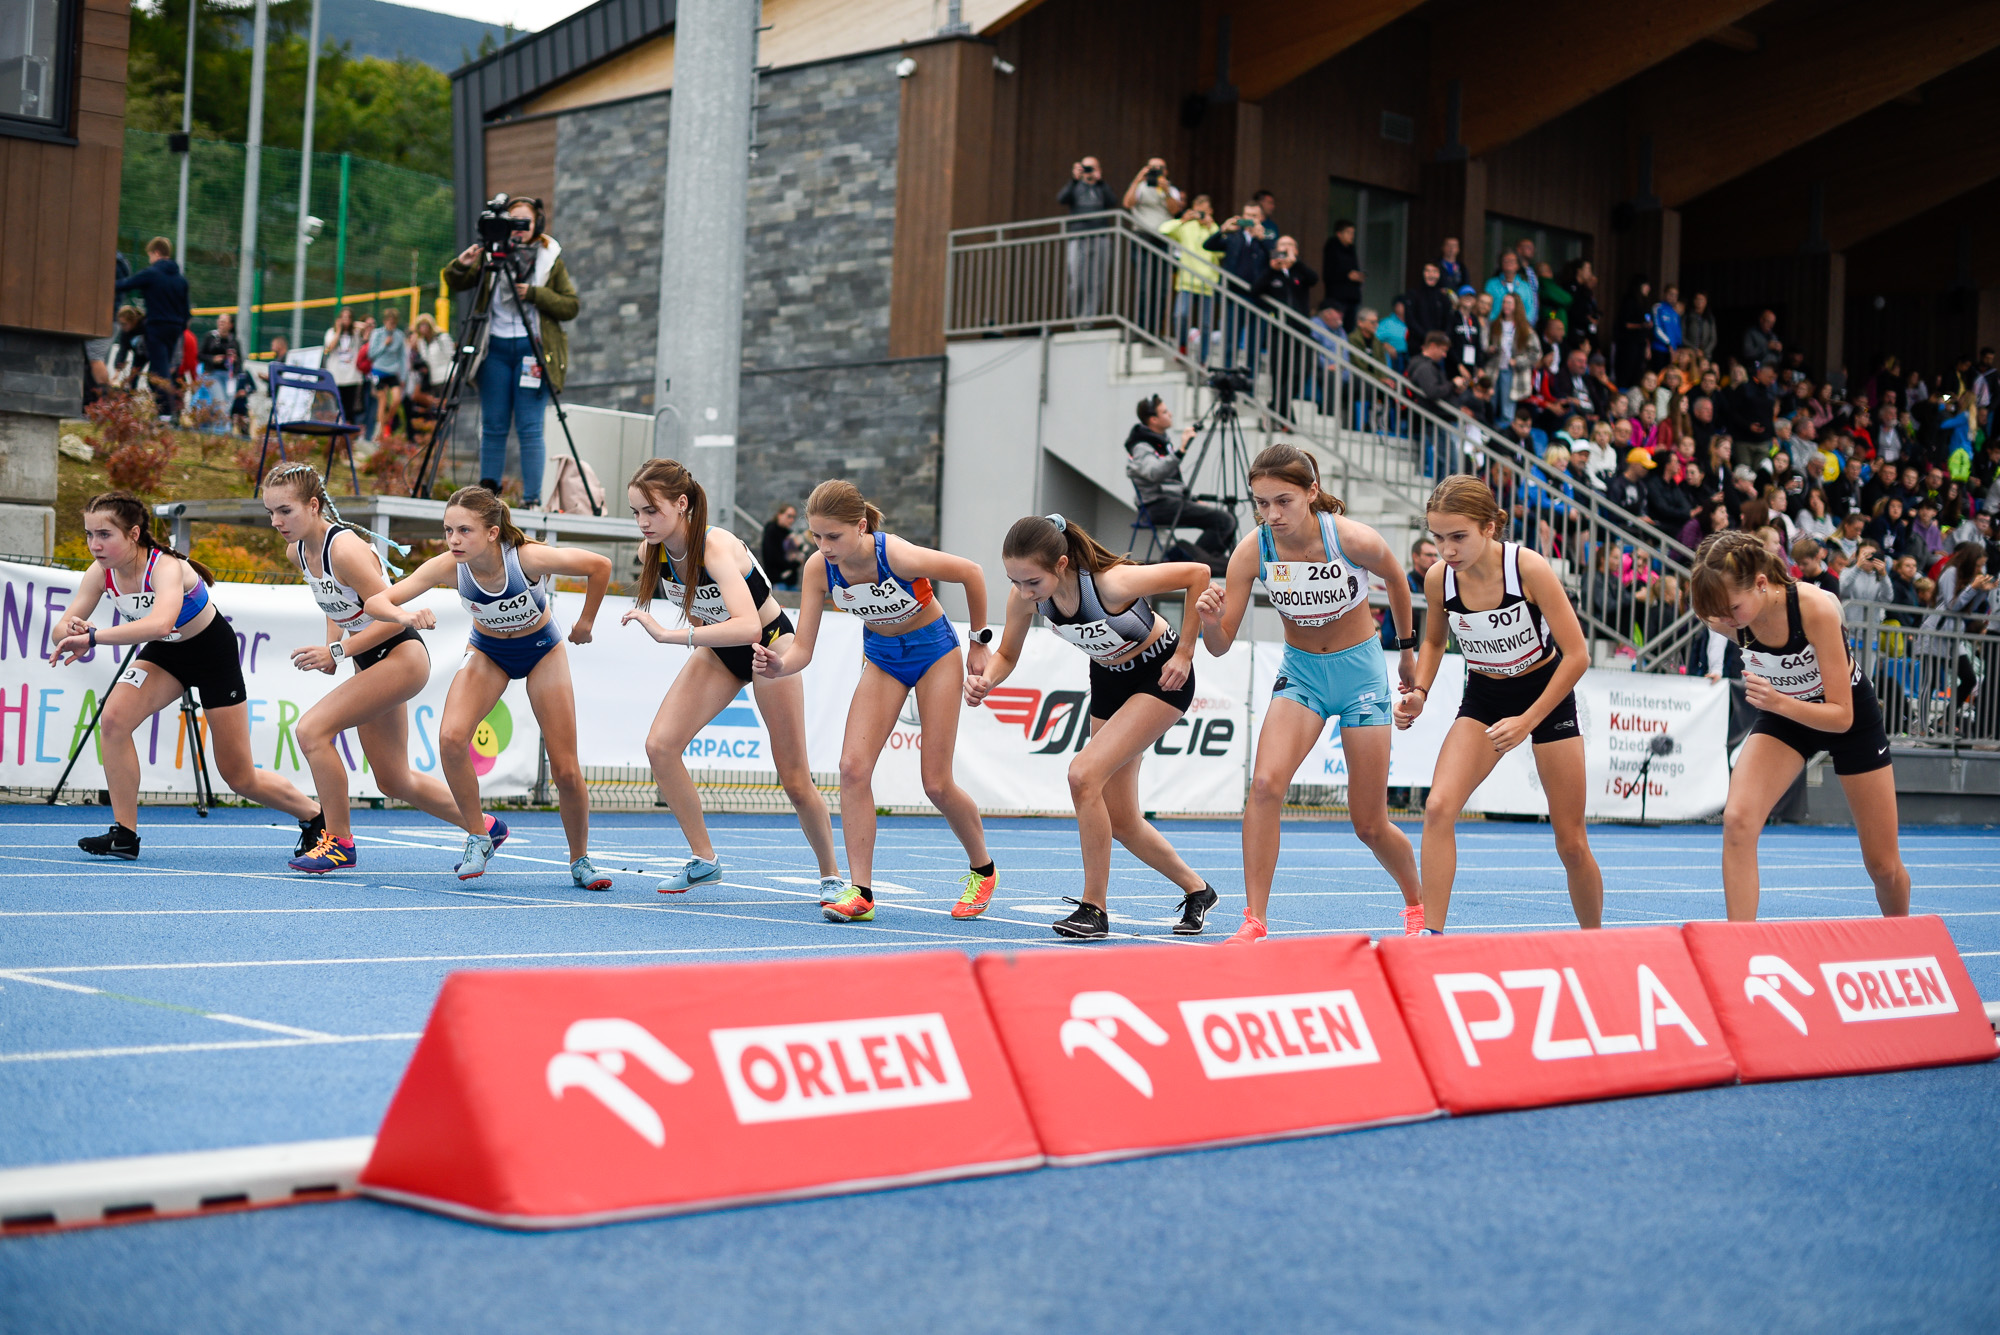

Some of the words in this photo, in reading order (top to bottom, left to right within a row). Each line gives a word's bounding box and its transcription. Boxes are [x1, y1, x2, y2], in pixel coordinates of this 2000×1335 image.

[1308, 564, 1341, 581] 260
[498, 595, 528, 612] 649
[1271, 588, 1347, 605] SOBOLEWSKA
[1322, 613, 1340, 625] 2021
[1488, 606, 1521, 629] 907
[1075, 623, 1107, 639] 725
[1460, 627, 1535, 653] FOLTYNIEWICZ
[1141, 624, 1178, 663] NIKE
[1515, 658, 1533, 672] 2021
[1780, 650, 1815, 669] 645
[1754, 667, 1821, 687] ZOSOWSK
[1609, 691, 1691, 711] Ministerstwo
[1610, 712, 1668, 734] Kultury
[682, 738, 761, 759] RPACZ
[1609, 736, 1682, 754] Dzieda
[1609, 756, 1684, 778] Naroowego
[1613, 777, 1668, 798] Spotu.
[1835, 963, 1947, 1012] ORLEN
[1432, 963, 1708, 1066] PZLA
[1201, 1001, 1367, 1063] ORLEN
[738, 1030, 950, 1103] ORLEN
